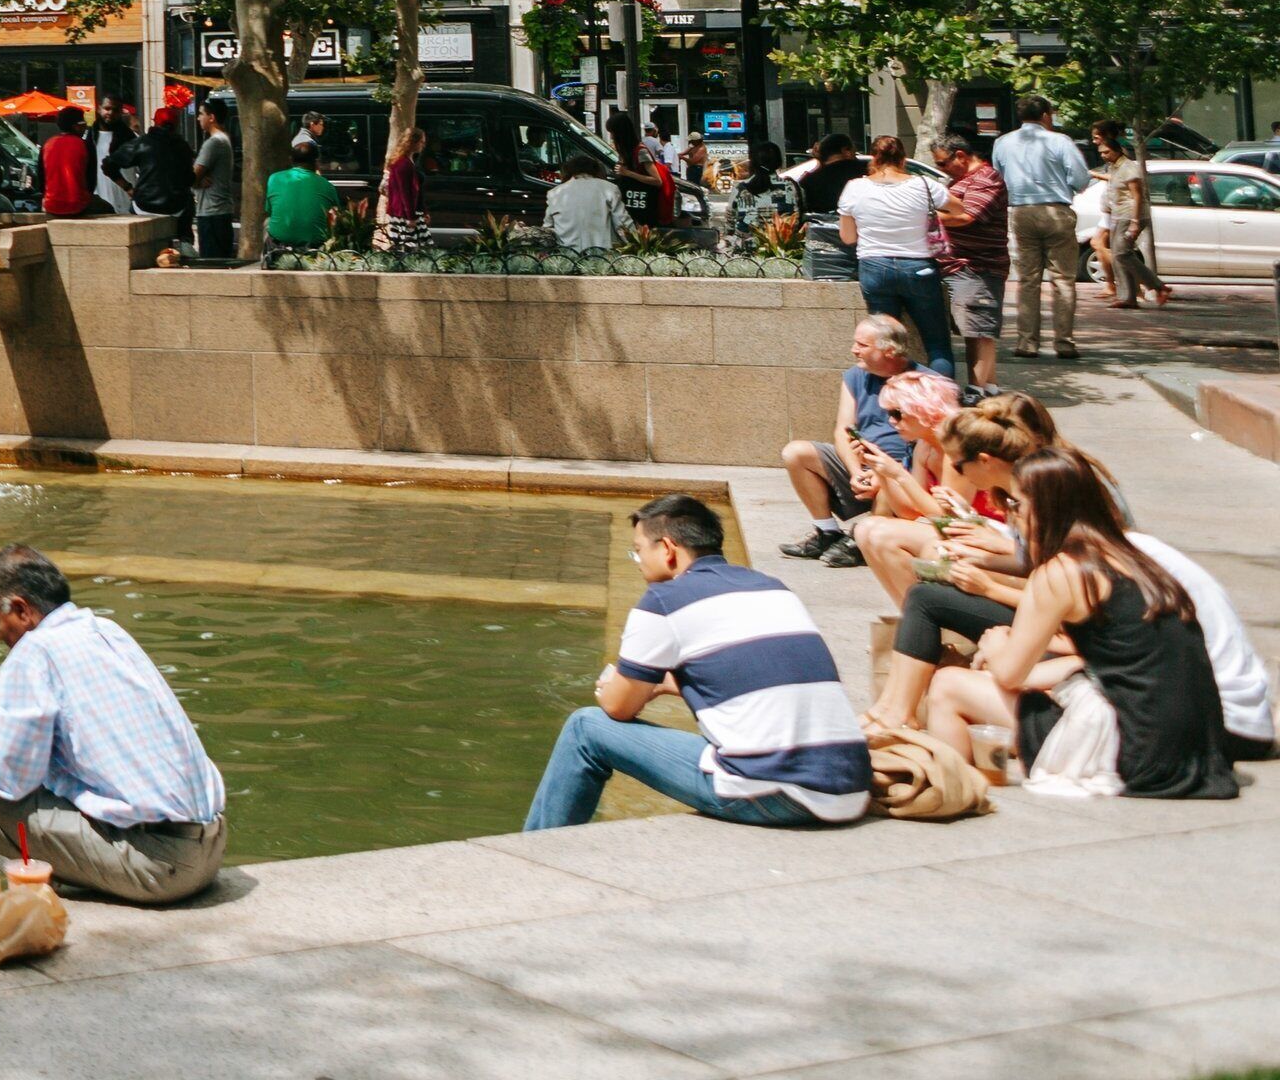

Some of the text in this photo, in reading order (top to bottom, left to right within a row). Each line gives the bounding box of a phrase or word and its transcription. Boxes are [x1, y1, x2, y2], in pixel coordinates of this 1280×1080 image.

[21, 16, 58, 24] company
[420, 36, 452, 45] URCH
[419, 46, 459, 56] OSTON
[626, 190, 647, 200] OFF
